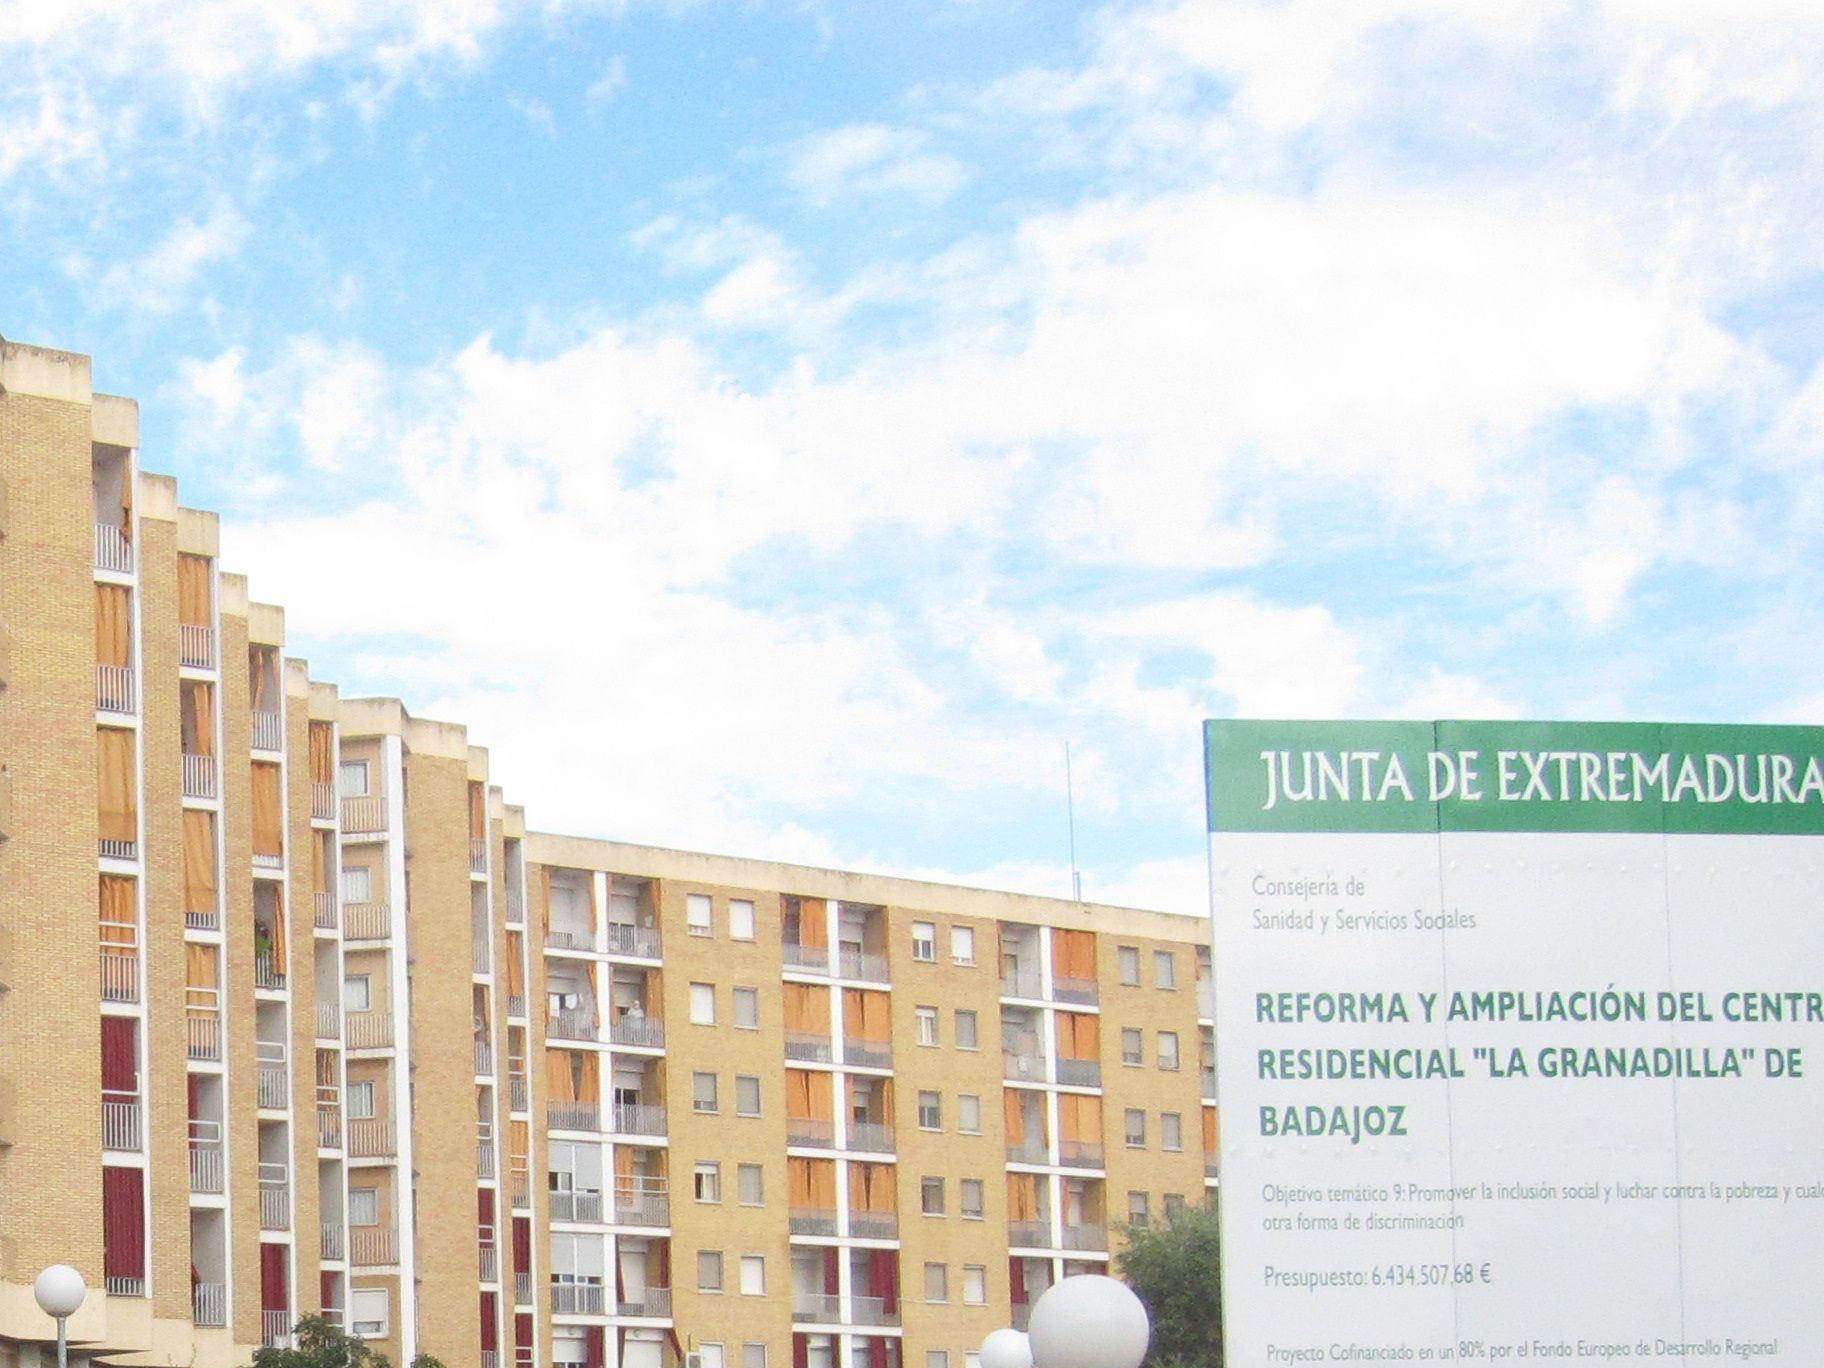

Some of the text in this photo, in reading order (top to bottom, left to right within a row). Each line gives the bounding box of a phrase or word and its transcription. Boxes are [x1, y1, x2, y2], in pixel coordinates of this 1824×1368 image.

[1260, 750, 1824, 811] JUNTA DE EXTREMADURA
[1252, 873, 1366, 900] Consejería de
[1252, 908, 1476, 934] Sanidad y Servicios Sociales
[1256, 992, 1409, 1023] REFORMA
[1418, 992, 1438, 1023] Y
[1447, 983, 1646, 1022] AMPLIACIÓN
[1657, 991, 1713, 1022] DEL
[1258, 1047, 1803, 1080] RESIDENCIAL "LA GRANADILLA" DE
[1259, 1105, 1408, 1145] BADAJOZ
[1262, 1184, 1323, 1207] Objetivo
[1327, 1183, 1388, 1202] temático
[1408, 1184, 1476, 1202] Promover
[1481, 1182, 1492, 1200] la
[1497, 1181, 1557, 1200] inclusión
[1562, 1181, 1599, 1200] social
[1604, 1186, 1612, 1204] y
[1616, 1181, 1658, 1200] luchar
[1663, 1183, 1706, 1200] contra
[1710, 1181, 1721, 1200] la
[1726, 1181, 1779, 1204] pobreza
[1783, 1186, 1791, 1204] y
[1263, 1211, 1464, 1230] otra forma de discriminación
[1264, 1262, 1492, 1293] Presupuesto: 6.434.507,68 €
[1267, 1338, 1778, 1366] Proyecto Cofinanciado en un 80% por el Fondo Europeo de Desarrollo Regional
